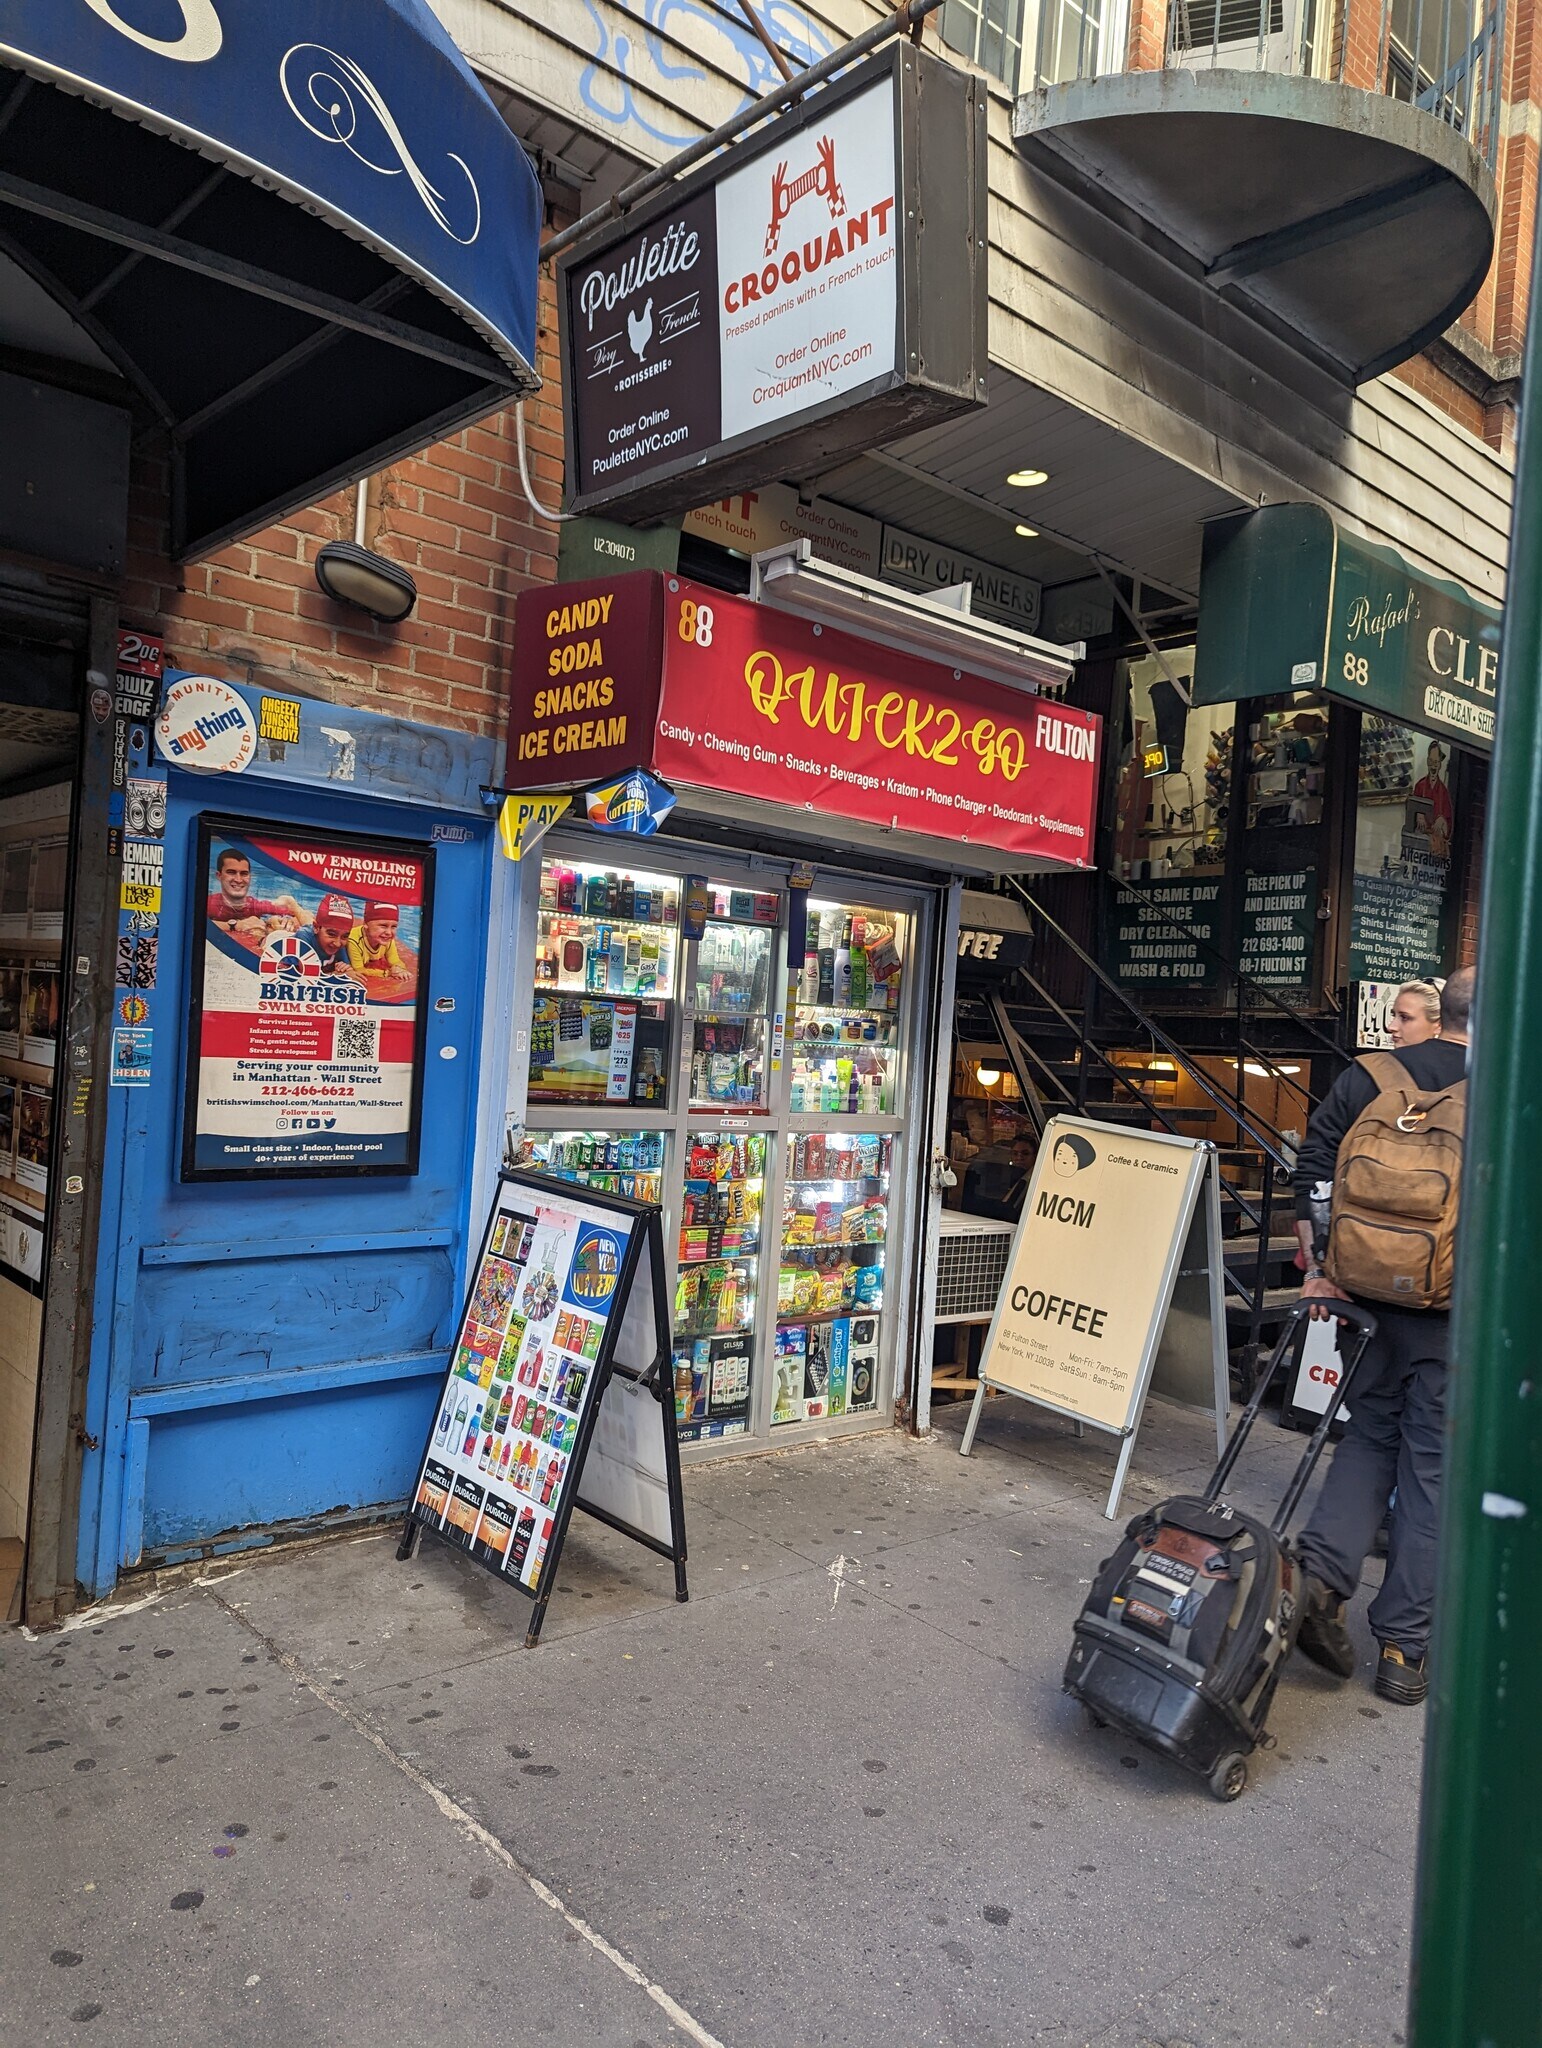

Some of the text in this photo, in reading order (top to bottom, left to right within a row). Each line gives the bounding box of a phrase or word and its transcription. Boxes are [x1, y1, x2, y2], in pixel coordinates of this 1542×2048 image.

[724, 196, 894, 314] CROQUANT
[580, 221, 700, 331] Poulette
[726, 247, 895, 340] Pressed paninis with a French touch
[775, 327, 846, 369] Order Online
[593, 349, 617, 373] Very
[619, 361, 668, 391] ROTISSERIE
[752, 341, 871, 404] CroquantNYC.com
[608, 407, 669, 443] Order Online
[593, 425, 688, 475] PouletteNYC.com
[796, 506, 825, 525] Order
[725, 520, 756, 541] touch
[891, 540, 930, 575] DRY
[546, 594, 613, 637] CANDY
[679, 600, 713, 646] 88
[1347, 588, 1420, 648] Rafael's
[548, 639, 602, 676] SODA
[1343, 652, 1368, 685] 88
[261, 697, 301, 715] OHGEEZY
[534, 677, 614, 718] SNACKS
[744, 650, 1029, 780] QUICK2GO
[1428, 692, 1472, 726] DRY CLEAN
[168, 707, 247, 756] anything
[518, 716, 627, 760] ICE CREAM
[1035, 714, 1095, 762] FULTON
[659, 720, 1084, 837] Candy Chewing Gum Snacks Beverages Kratom Phone Charger Deodorant Supplements
[288, 850, 416, 876] NOW ENROLLING
[1401, 847, 1451, 871] Alterations
[323, 868, 416, 889] NEW STUDENTS!
[1248, 874, 1306, 892] FREE PICK UP
[1117, 886, 1219, 904] RUSH SAME DAY
[1363, 892, 1428, 913] Drapery Cleaning
[1367, 881, 1442, 904] Quality Dry Cleaning
[1138, 906, 1193, 921] SERVICE
[1244, 895, 1307, 912] AND DELIVERY
[1255, 916, 1293, 932] SERVICE
[1361, 917, 1427, 938] Shirts Laundering
[1389, 909, 1439, 928] Furs Cleaning
[1119, 927, 1146, 940] DRY
[1243, 936, 1305, 952] 212 693-1400
[1360, 929, 1427, 948] Shirts Hand Press
[1130, 944, 1196, 958] TAILORING
[1375, 944, 1441, 963] Design Tailoring
[1119, 964, 1205, 977] WASH & FOLD
[1240, 957, 1306, 972] 88-7 FULTON ST
[1365, 955, 1419, 970] WASH FOLD
[1368, 968, 1381, 977] 212
[260, 983, 366, 1004] BRITISH
[258, 1002, 366, 1016] SWIM SCHOOL
[258, 1018, 288, 1026] Survival
[274, 1048, 317, 1056] development
[237, 1061, 380, 1074] Serving your community
[233, 1073, 382, 1084] in Manhattan Wall Street
[261, 1086, 354, 1096] 212-466-6622
[207, 1099, 403, 1107] britishswimschool.com/Manhattan/Wall-Street
[365, 1143, 382, 1151] pool
[1107, 1153, 1131, 1167] Coffee
[1141, 1160, 1178, 1175] Ceramics
[1036, 1191, 1096, 1229] MCM
[599, 1239, 615, 1253] NEW
[1010, 1285, 1107, 1338] COFFEE
[724, 1341, 744, 1349] CELSIUS
[1003, 1329, 1048, 1351] 88 Fulton Street
[998, 1341, 1054, 1368] New NY 10038
[1069, 1352, 1128, 1379] Mon-Fri: 7am-5pm
[1093, 1376, 1125, 1392] 8am-5pm
[425, 1469, 450, 1489] DURACELL
[454, 1485, 480, 1506] DURACELL
[485, 1504, 512, 1525] DURACELL
